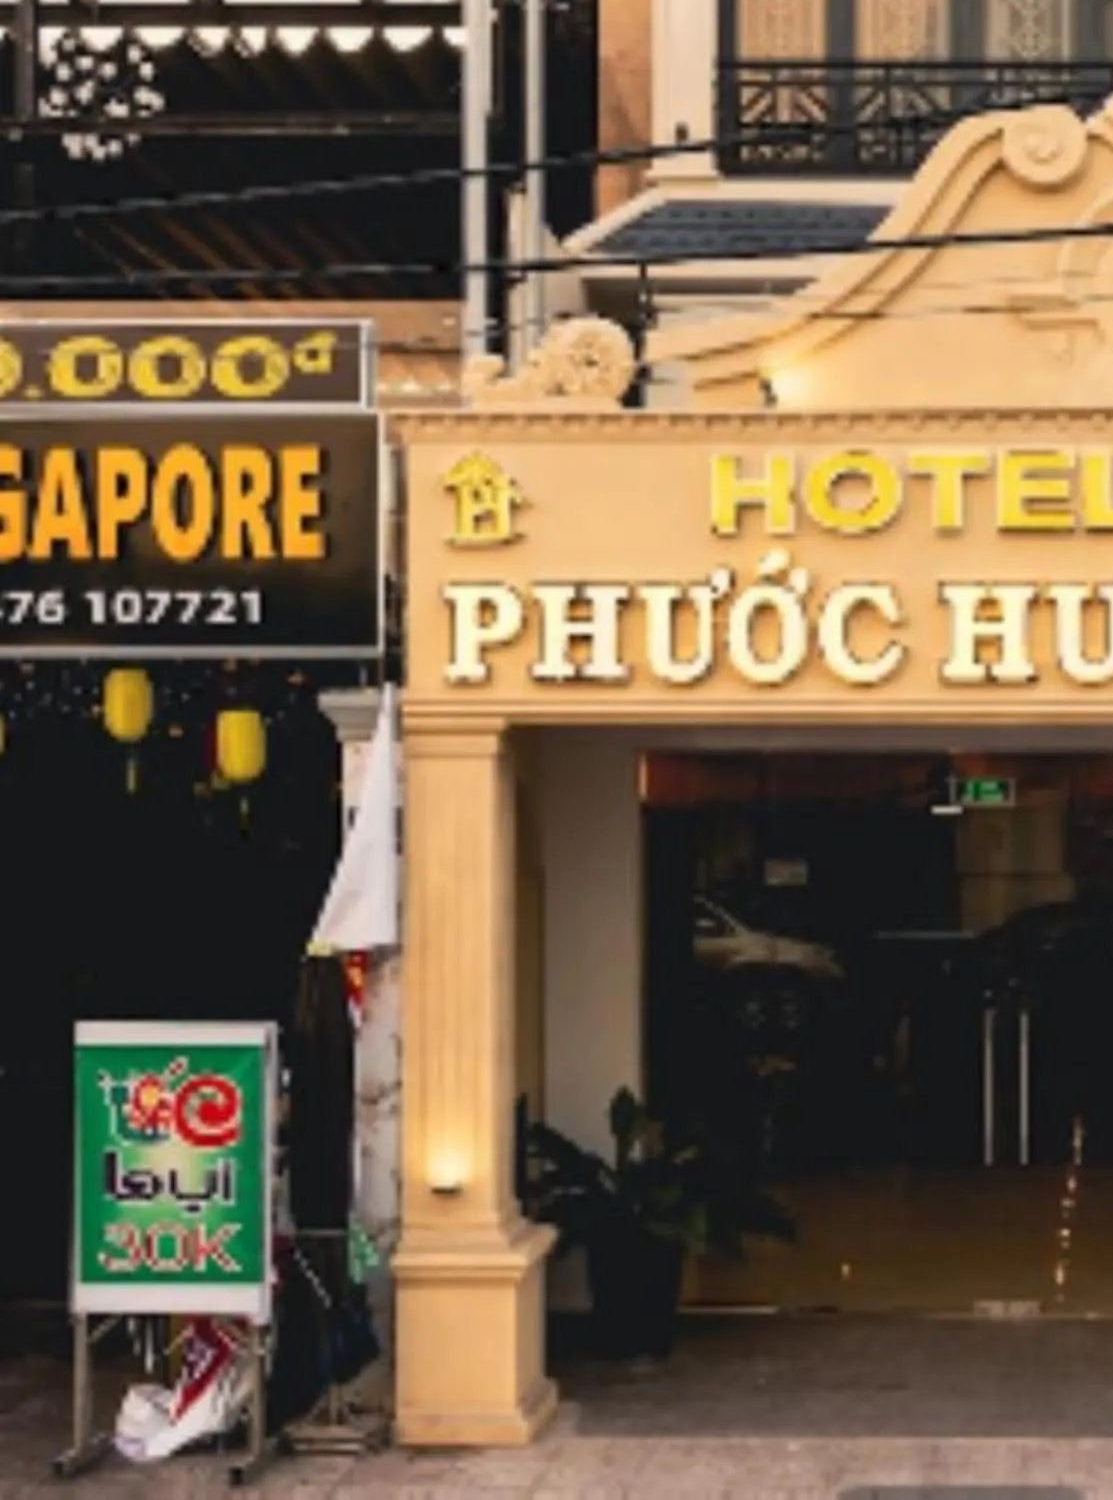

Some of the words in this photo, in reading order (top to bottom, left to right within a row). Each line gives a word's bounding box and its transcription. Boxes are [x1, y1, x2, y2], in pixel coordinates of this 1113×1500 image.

[0, 590, 65, 624] 76
[86, 590, 262, 624] 107721
[443, 548, 906, 685] PHƯỚC
